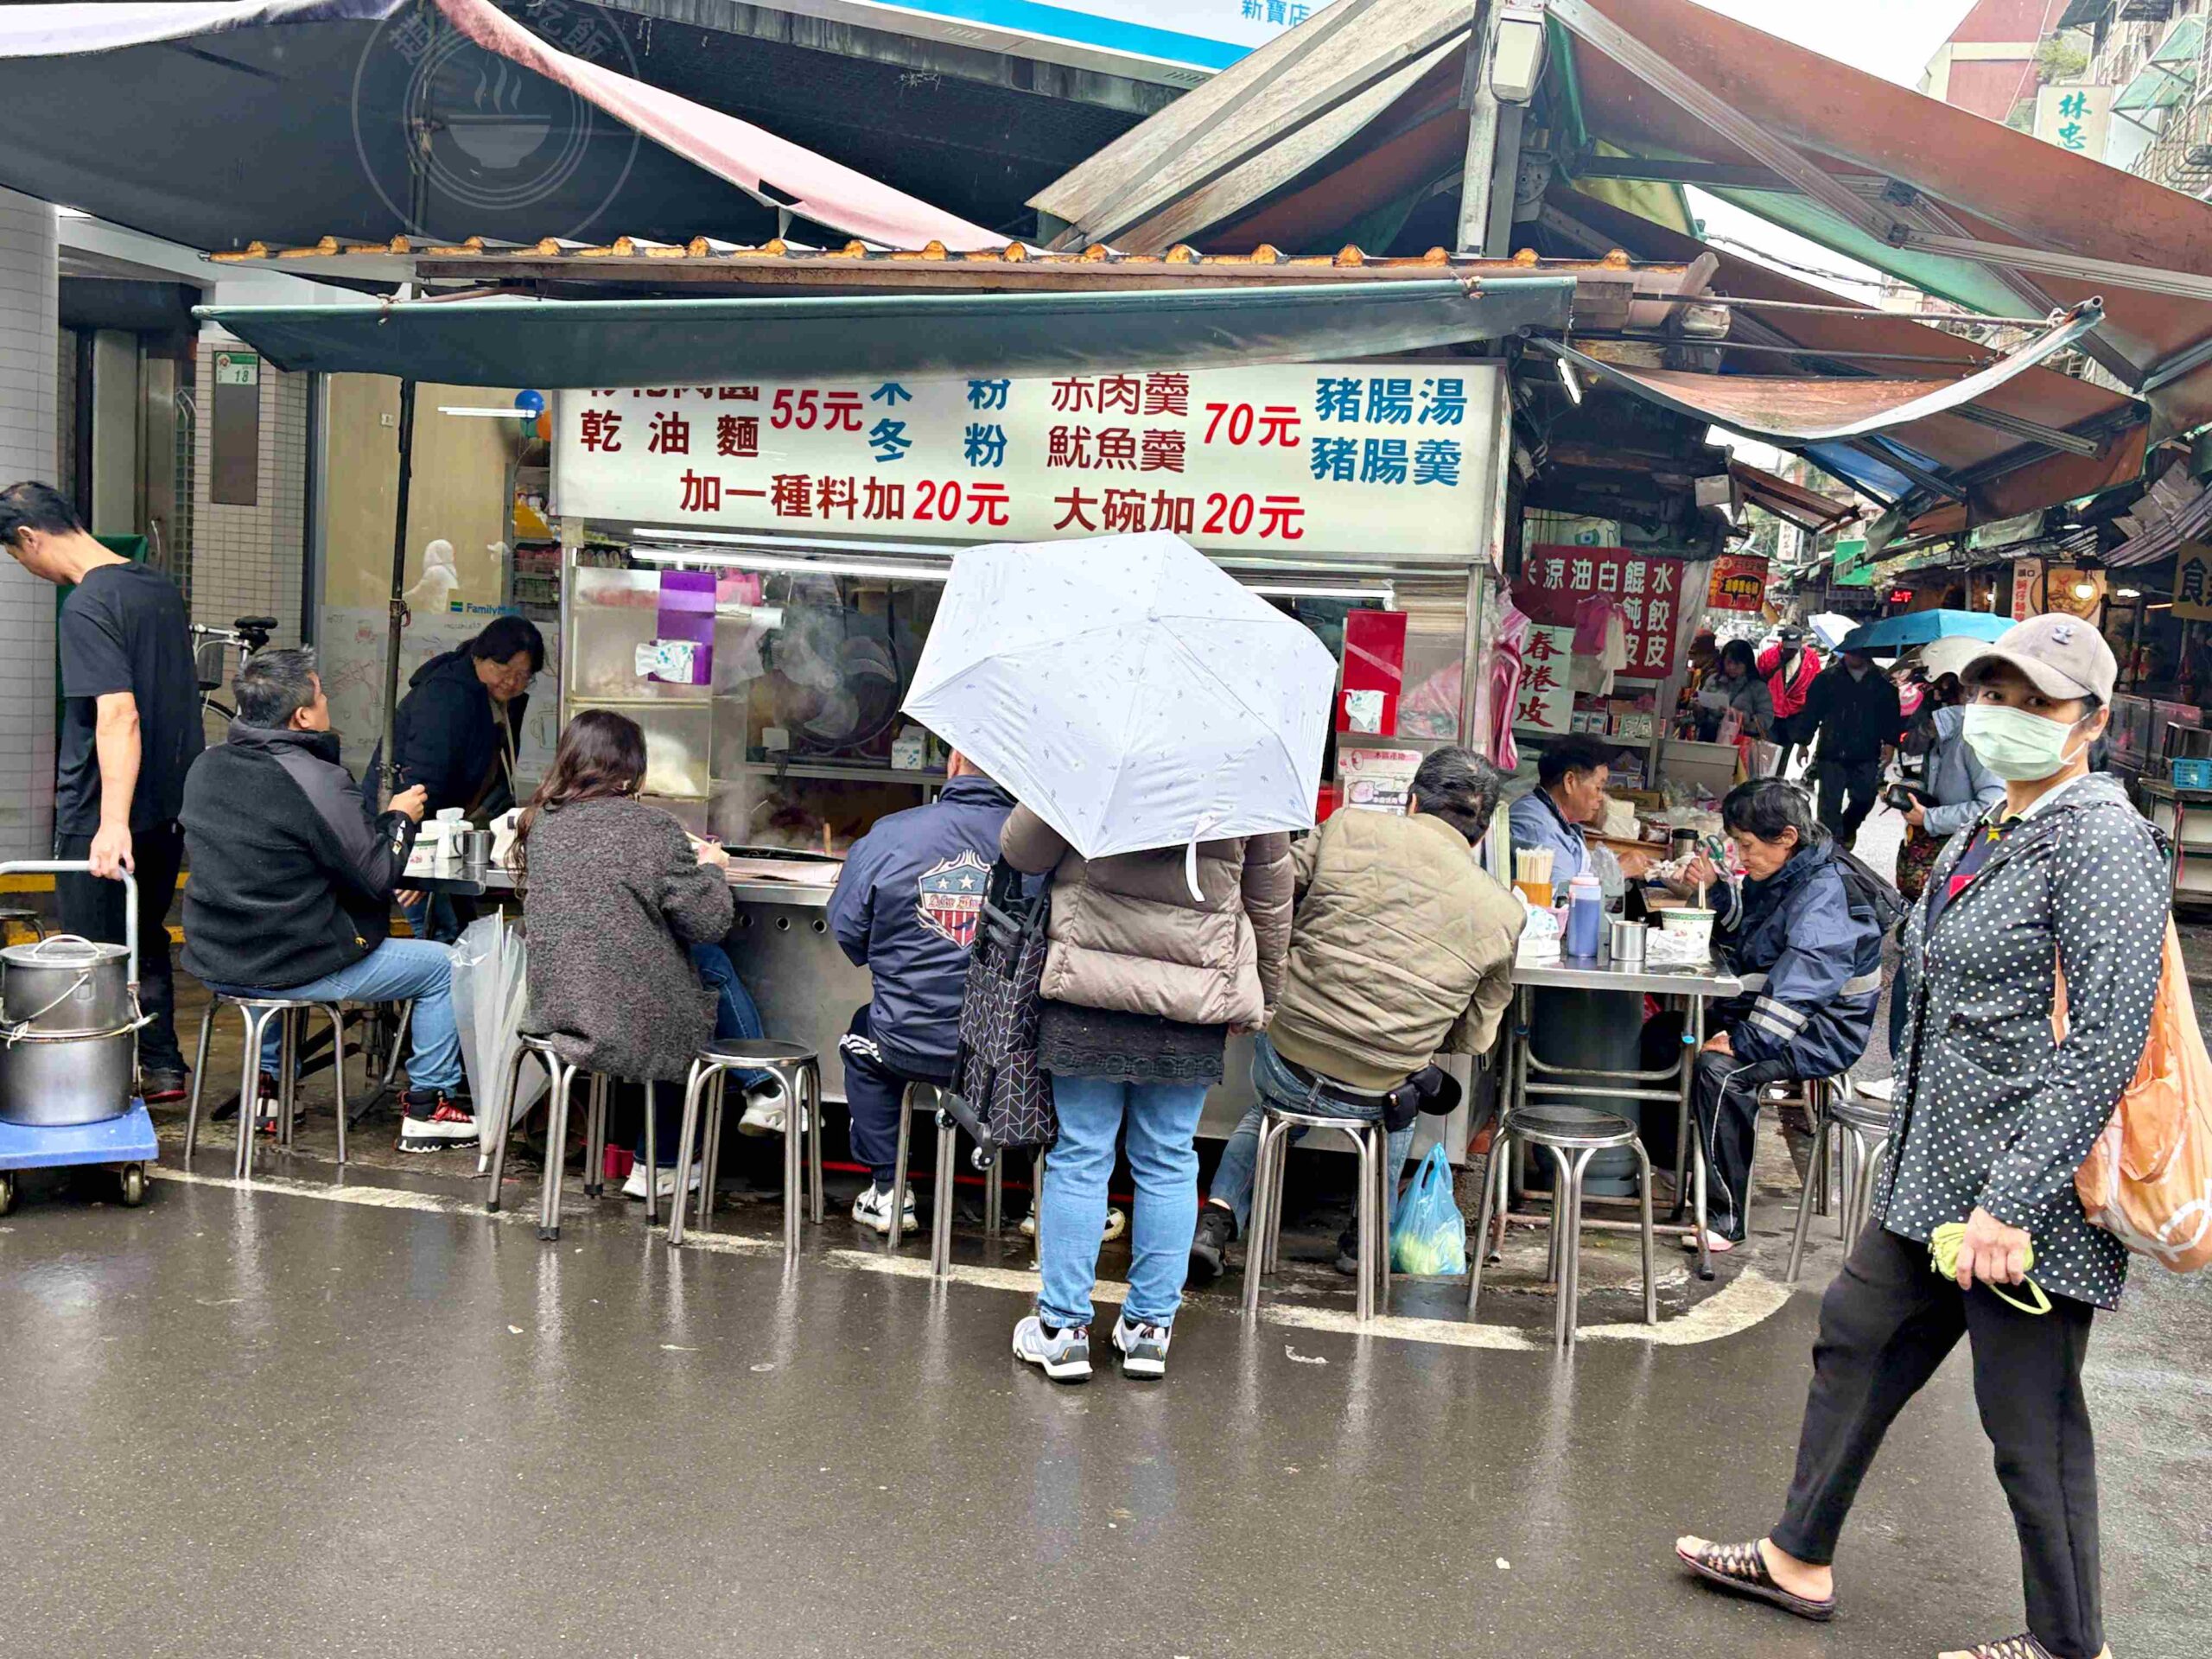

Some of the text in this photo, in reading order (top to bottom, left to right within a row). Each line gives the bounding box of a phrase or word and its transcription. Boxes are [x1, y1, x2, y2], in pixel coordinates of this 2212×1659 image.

[1242, 0, 1311, 26] 新寶店
[235, 370, 249, 382] 18
[770, 390, 863, 431] 55元
[1204, 402, 1301, 448] 70元
[1315, 378, 1467, 426] 豬腸湯
[1047, 425, 1186, 474] 魷魚羹
[1310, 436, 1462, 486] 豬腸羹
[467, 602, 521, 616] FamilyM
[1515, 630, 1565, 728] 春捲皮
